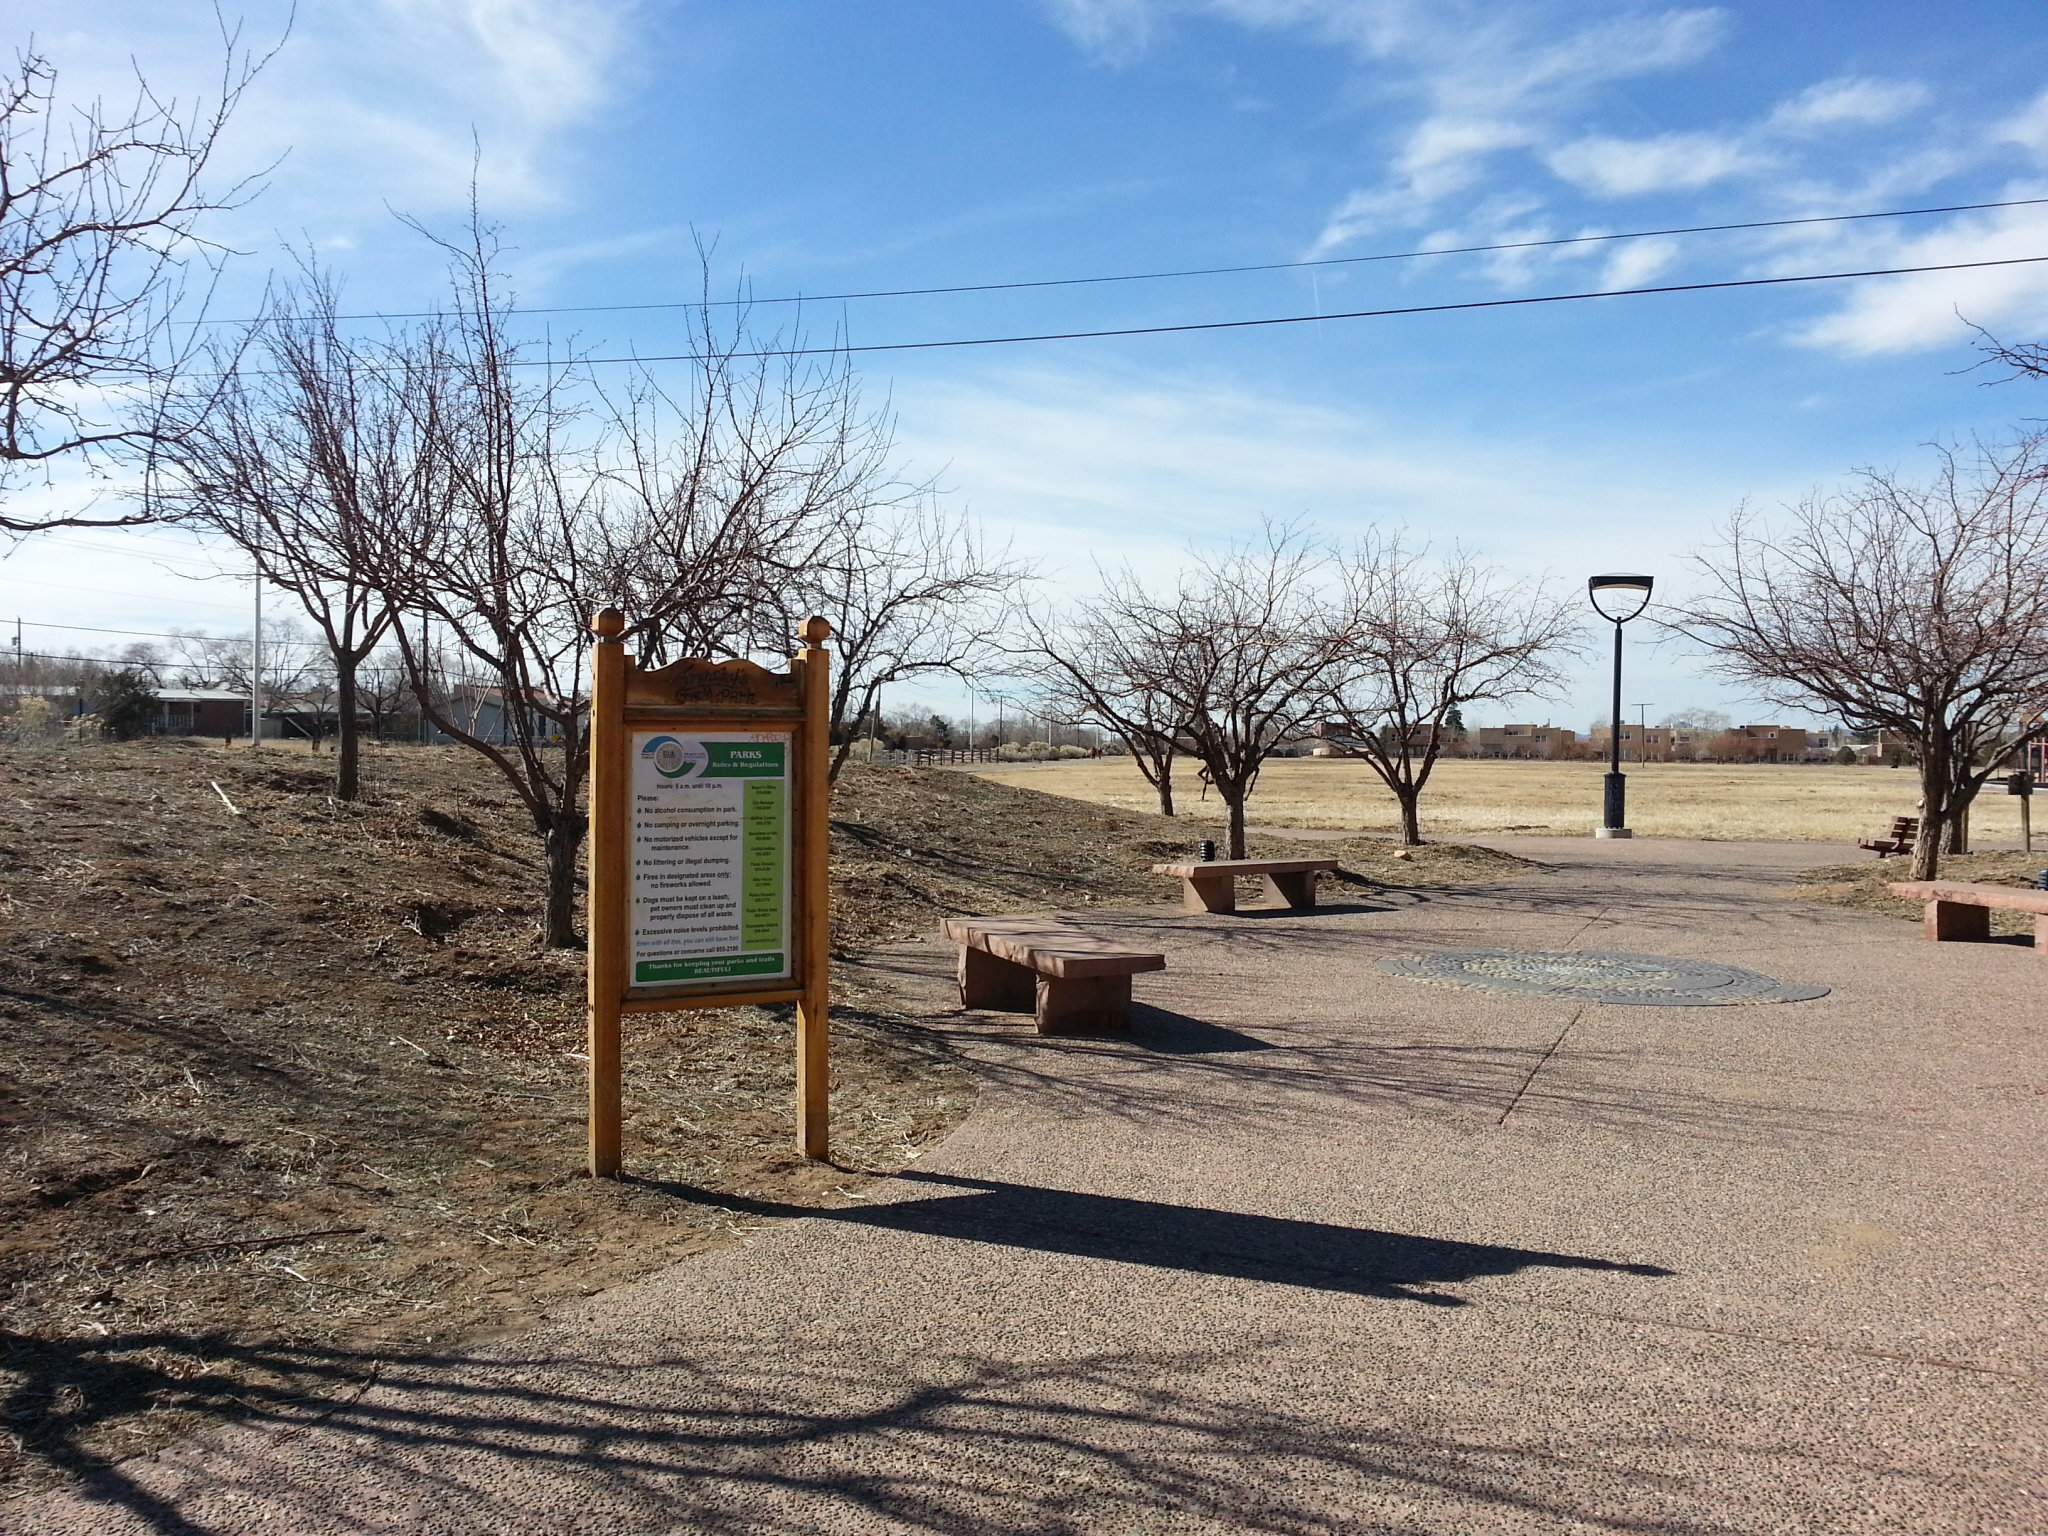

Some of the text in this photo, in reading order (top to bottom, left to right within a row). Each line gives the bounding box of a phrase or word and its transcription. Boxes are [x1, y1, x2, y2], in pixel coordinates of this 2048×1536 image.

[730, 750, 762, 758] PARKS
[650, 914, 674, 922] properly
[709, 924, 739, 933] prohibited.
